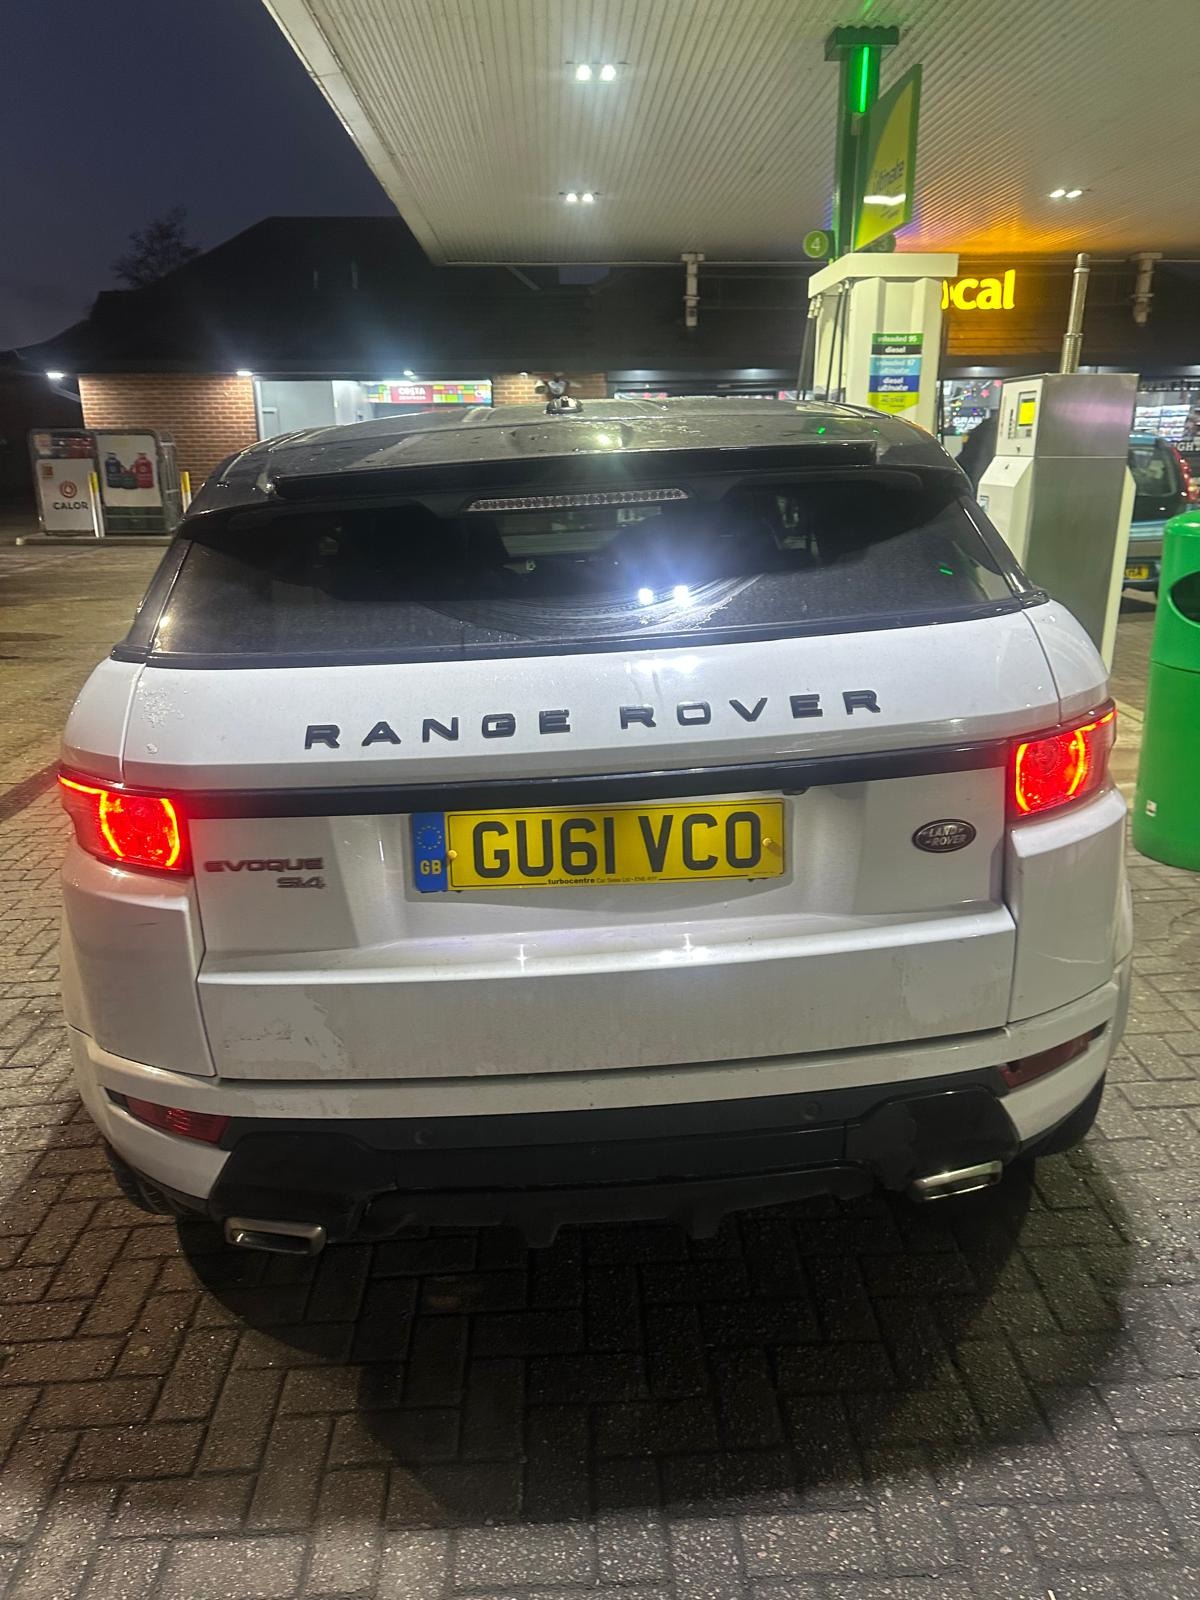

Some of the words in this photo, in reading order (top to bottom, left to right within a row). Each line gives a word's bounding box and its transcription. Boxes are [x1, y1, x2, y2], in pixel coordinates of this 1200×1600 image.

[810, 237, 821, 251] 4
[52, 501, 89, 510] CALOR
[304, 709, 571, 750] RANGE
[619, 689, 881, 730] ROVER
[929, 825, 957, 838] LAND
[472, 819, 616, 878] GU61
[637, 811, 762, 873] VCO
[204, 857, 323, 873] EVOQUE
[419, 859, 442, 875] GB
